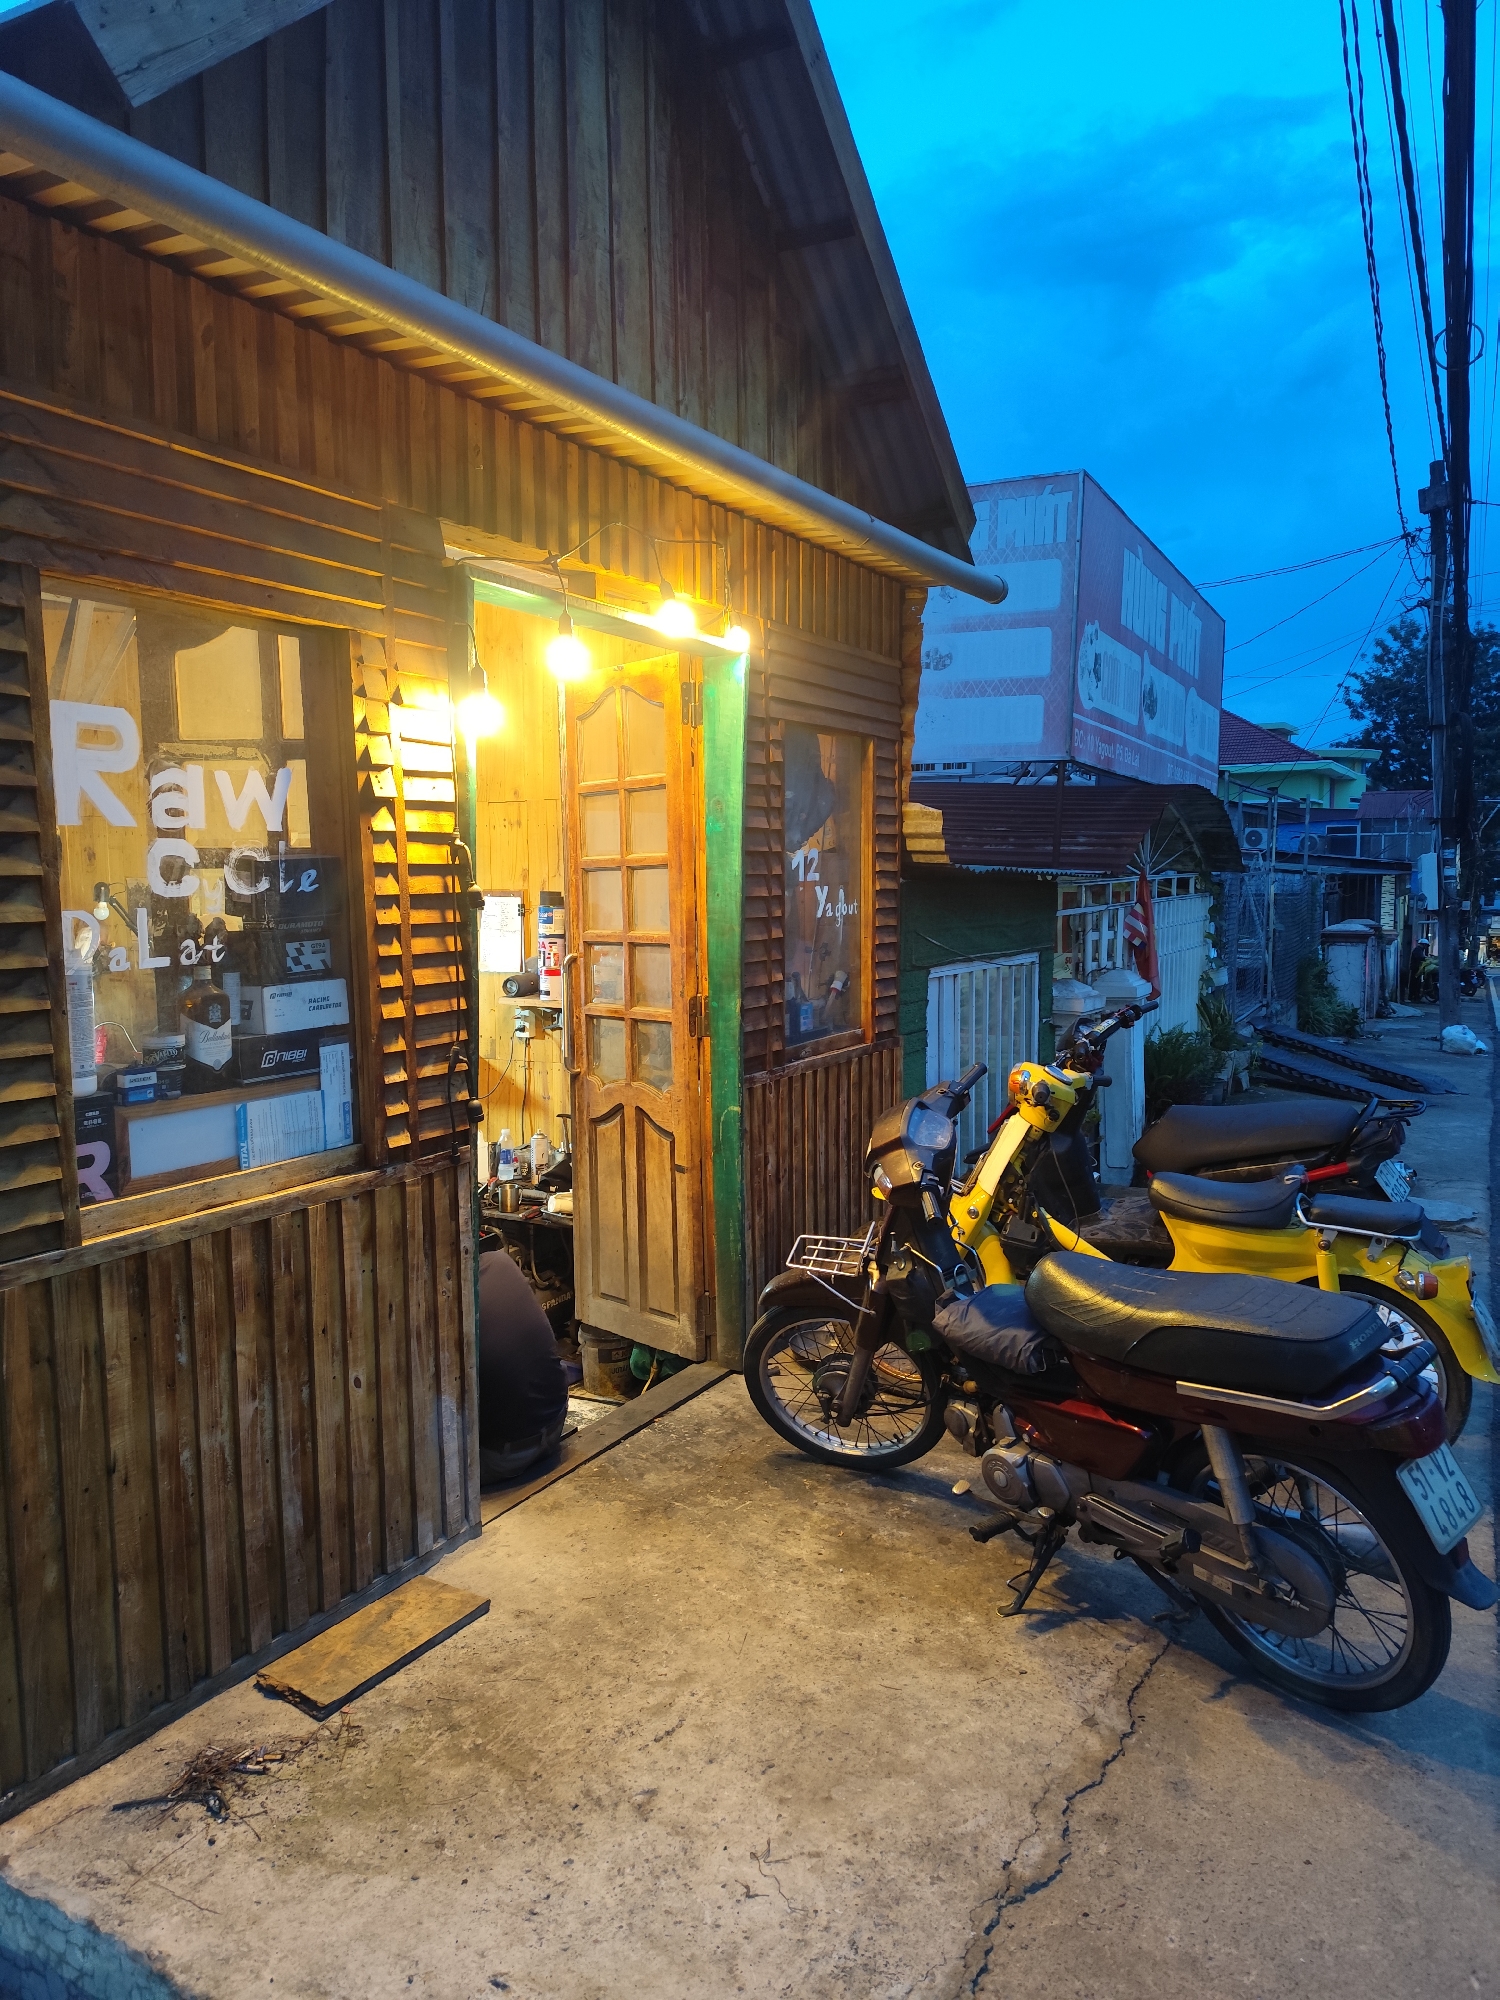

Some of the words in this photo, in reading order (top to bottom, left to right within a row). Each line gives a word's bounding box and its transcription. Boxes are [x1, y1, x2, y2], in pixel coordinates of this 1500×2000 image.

[996, 484, 1073, 550] PHÁT
[50, 699, 292, 832] Raw
[791, 847, 820, 882] 12
[277, 920, 324, 931] DURAMOTO
[1429, 1480, 1476, 1538] 4848
